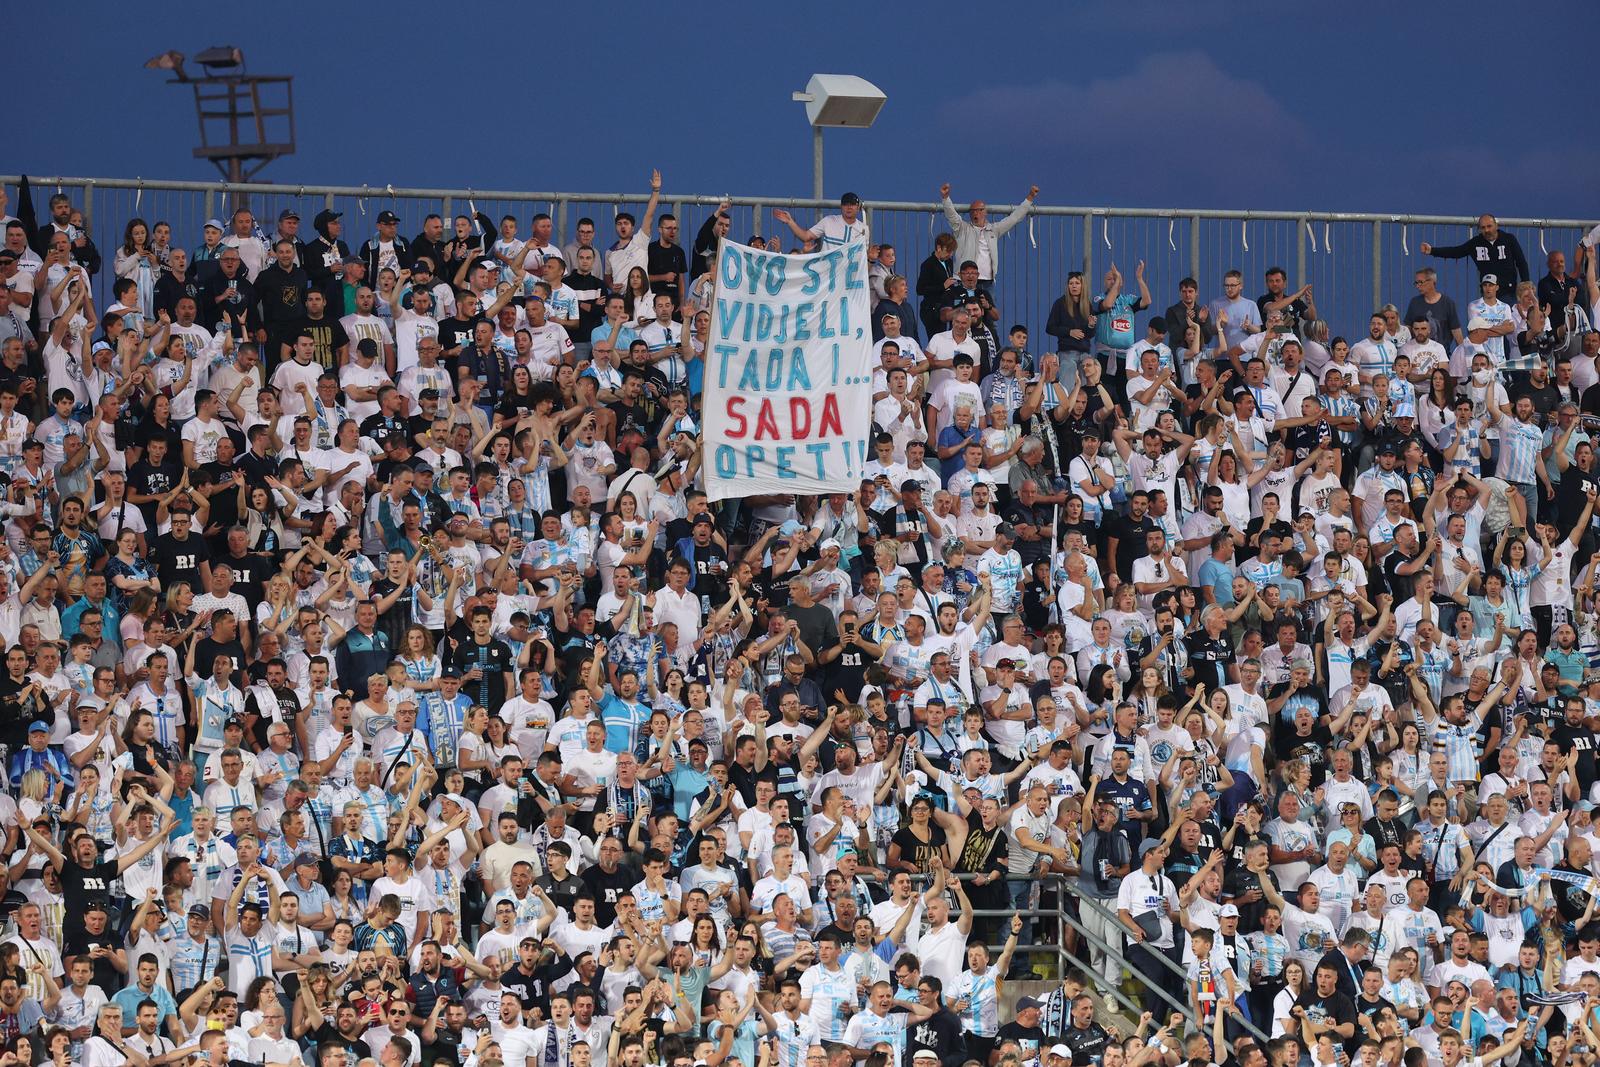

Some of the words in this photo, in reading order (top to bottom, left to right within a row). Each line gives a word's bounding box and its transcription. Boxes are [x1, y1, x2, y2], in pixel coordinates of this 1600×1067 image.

[721, 245, 786, 296] OVO
[801, 243, 864, 295] STE
[717, 296, 863, 344] VIDJELI,
[714, 344, 812, 392] TADA
[724, 392, 843, 441] SADA
[176, 554, 195, 569] RI
[841, 653, 861, 666] RI
[1572, 737, 1592, 751] RI
[1084, 1037, 1104, 1048] FAVBET
